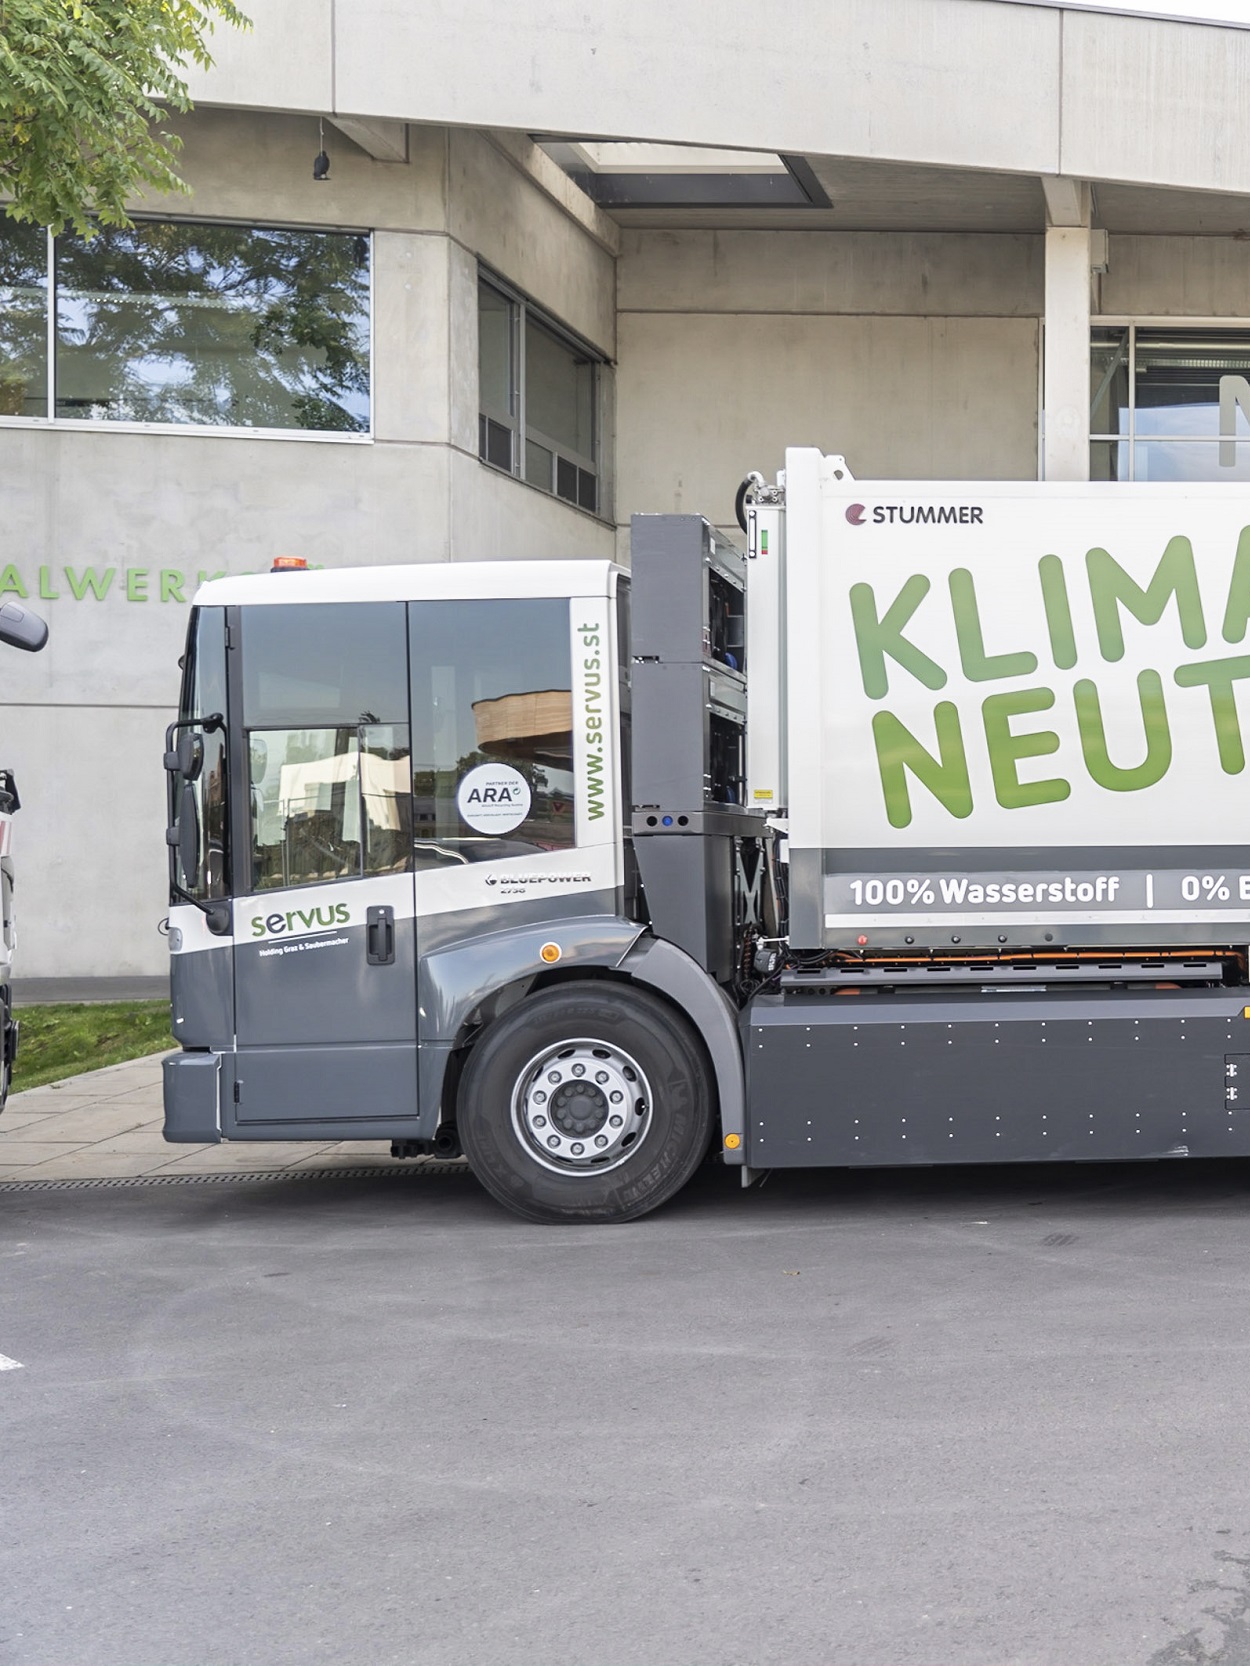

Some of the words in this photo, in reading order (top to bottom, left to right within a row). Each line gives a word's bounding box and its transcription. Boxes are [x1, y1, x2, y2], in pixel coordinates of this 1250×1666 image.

[872, 506, 984, 524] STUMMER
[0, 563, 228, 602] ALWER
[577, 622, 605, 821] www.servus.st
[467, 787, 513, 803] ARA
[849, 878, 935, 906] 100%
[939, 876, 1120, 905] Wasserstoff
[1181, 875, 1231, 901] 0%
[251, 902, 351, 937] servus
[259, 946, 284, 957] Holding
[284, 945, 298, 953] Graz
[304, 937, 349, 950] Saubermacher
